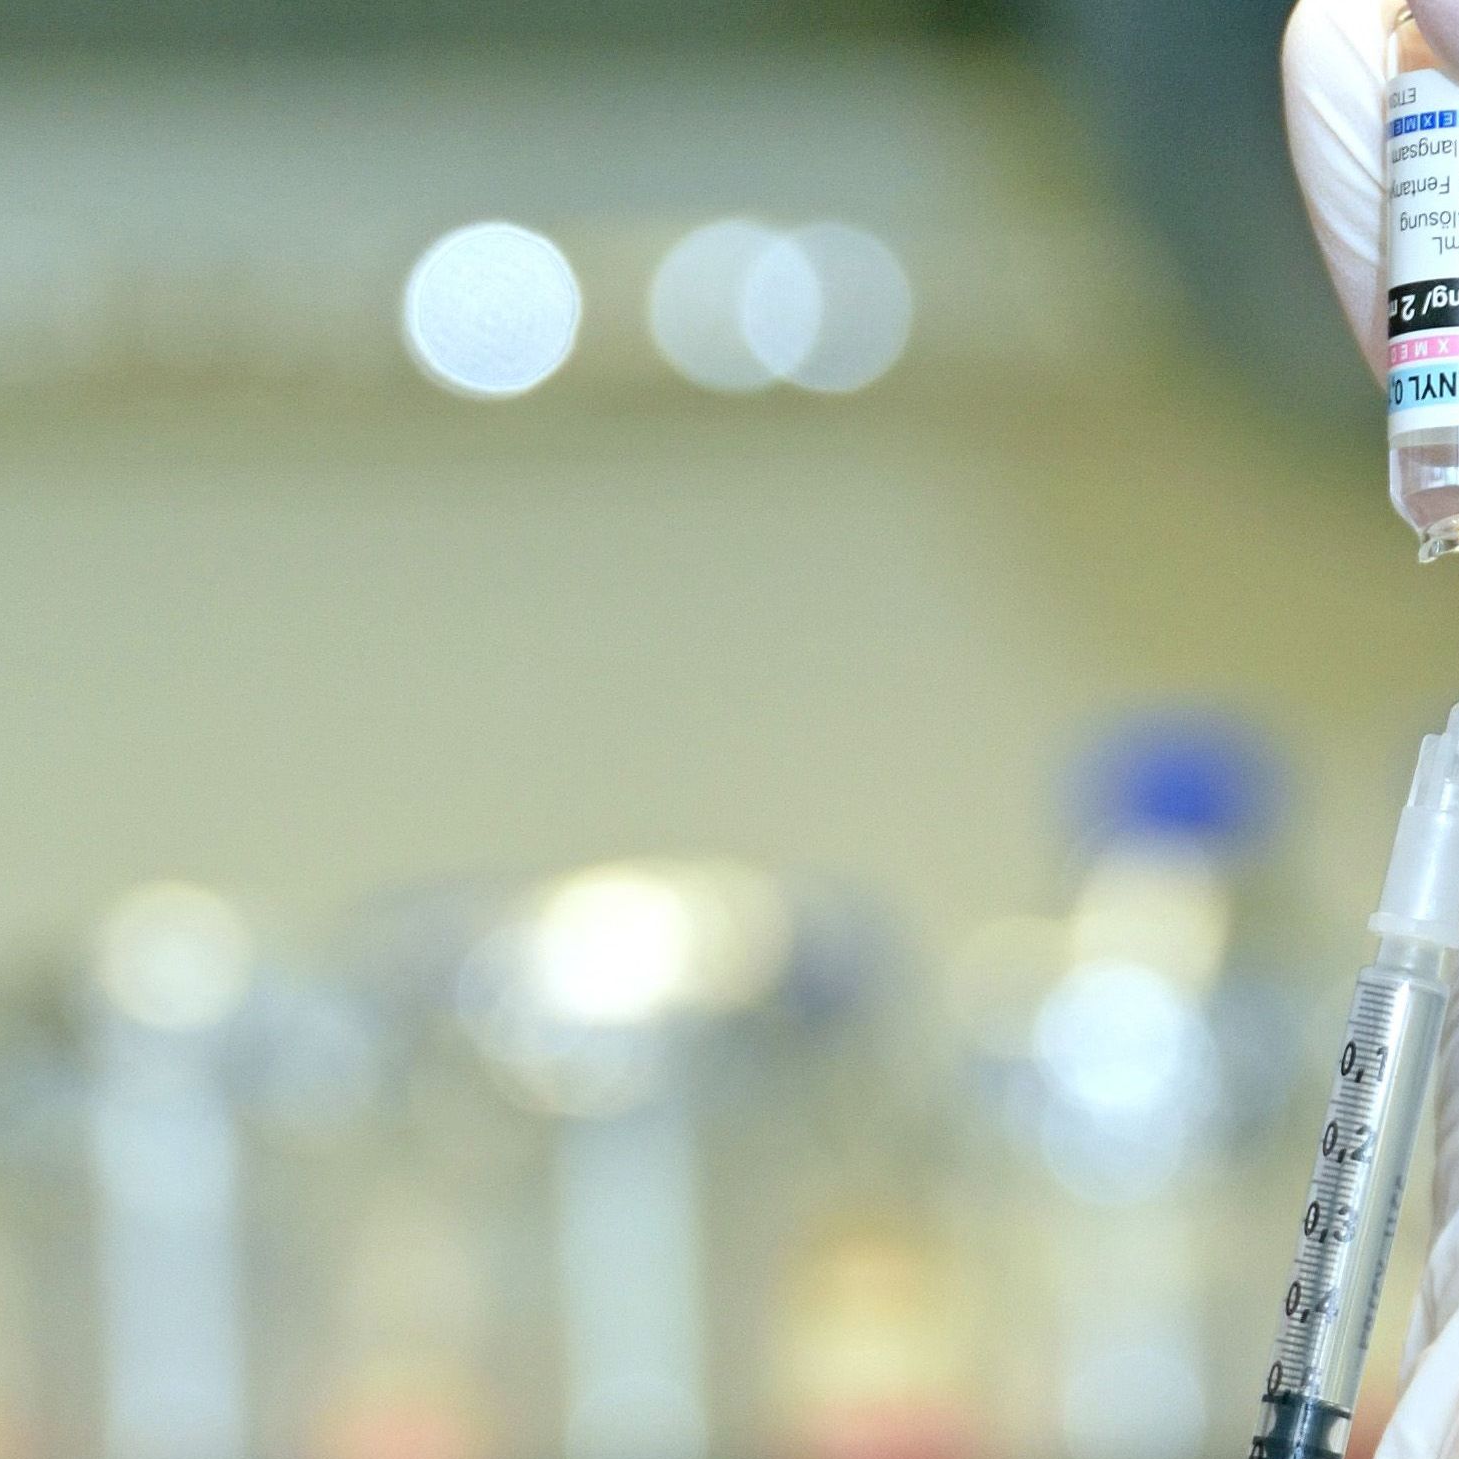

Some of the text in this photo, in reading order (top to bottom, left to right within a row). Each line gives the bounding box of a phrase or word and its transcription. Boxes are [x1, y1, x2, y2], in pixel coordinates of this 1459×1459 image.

[1392, 137, 1458, 164] langsam
[1341, 1041, 1389, 1084] 0,1
[1322, 1120, 1376, 1165] 0,2
[1304, 1200, 1358, 1245] 0,3
[1284, 1280, 1340, 1325] 0,4
